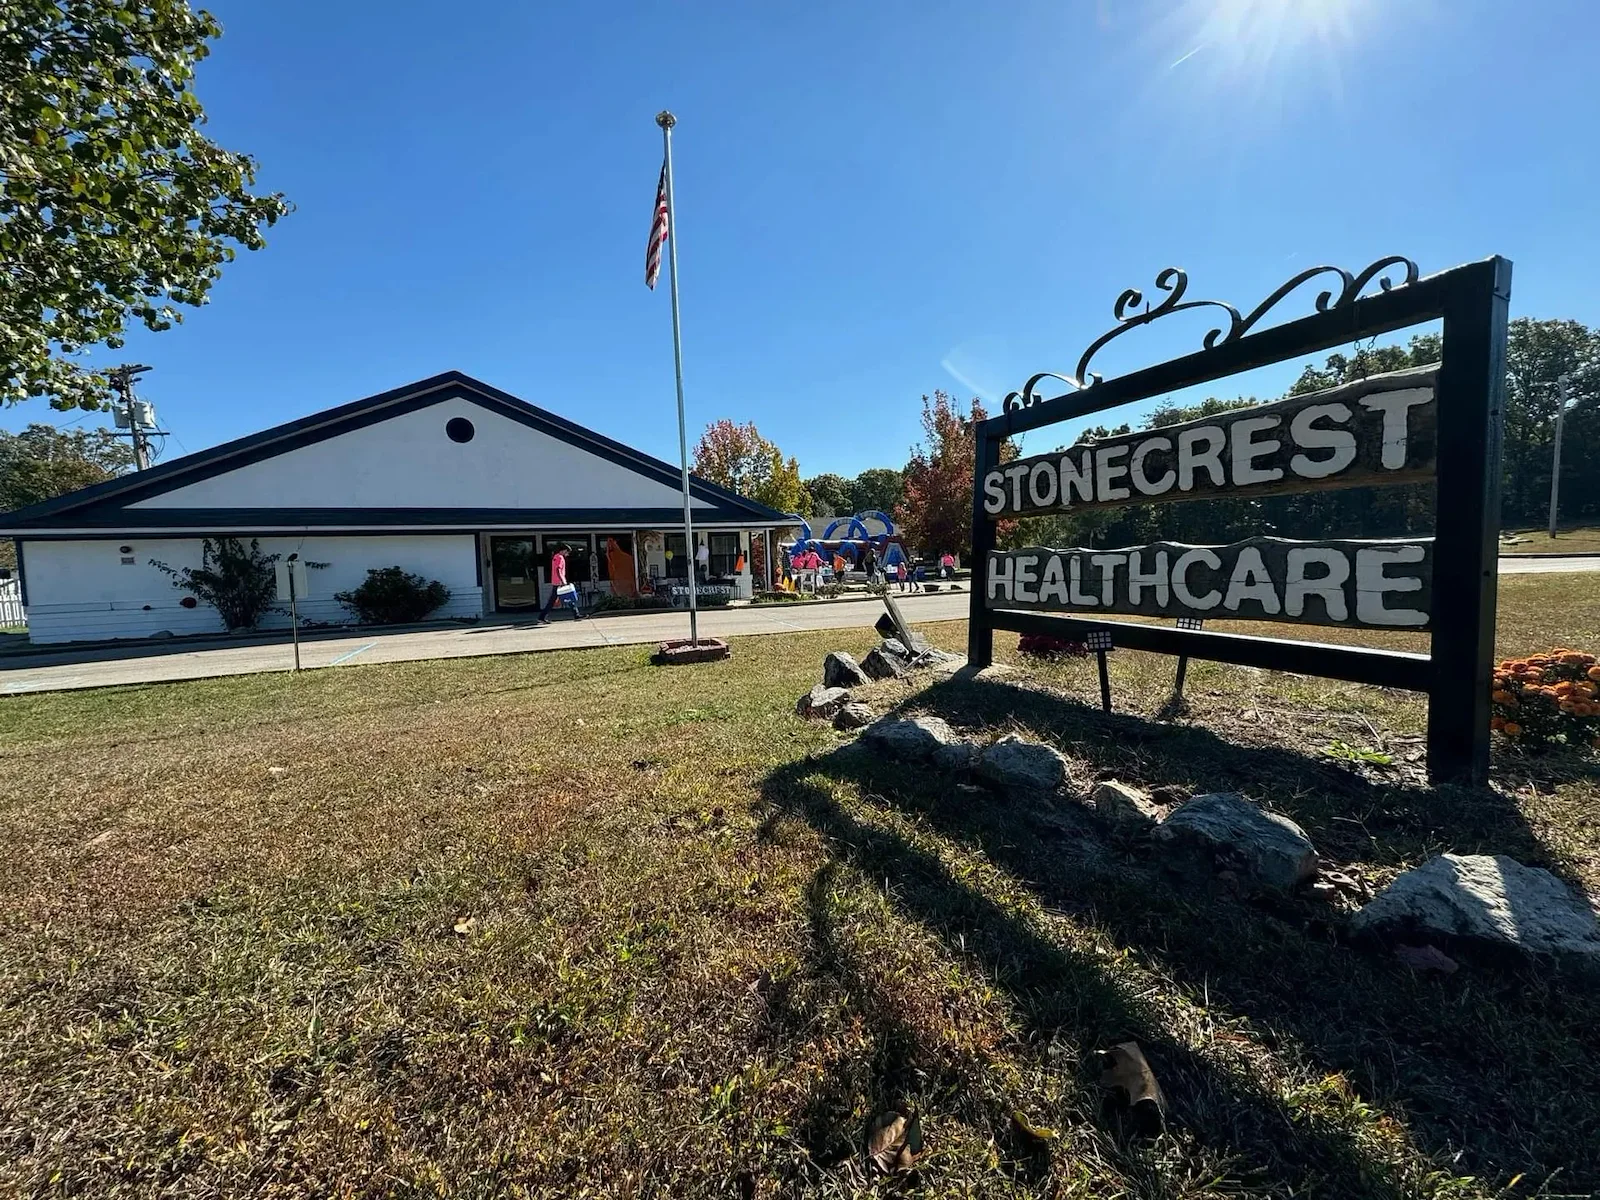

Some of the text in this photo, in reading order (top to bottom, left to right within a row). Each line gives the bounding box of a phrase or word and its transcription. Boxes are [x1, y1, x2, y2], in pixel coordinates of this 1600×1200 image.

[983, 387, 1434, 514] STONECREST
[671, 585, 730, 595] STOECREST
[988, 545, 1430, 626] HEALTHCARE
